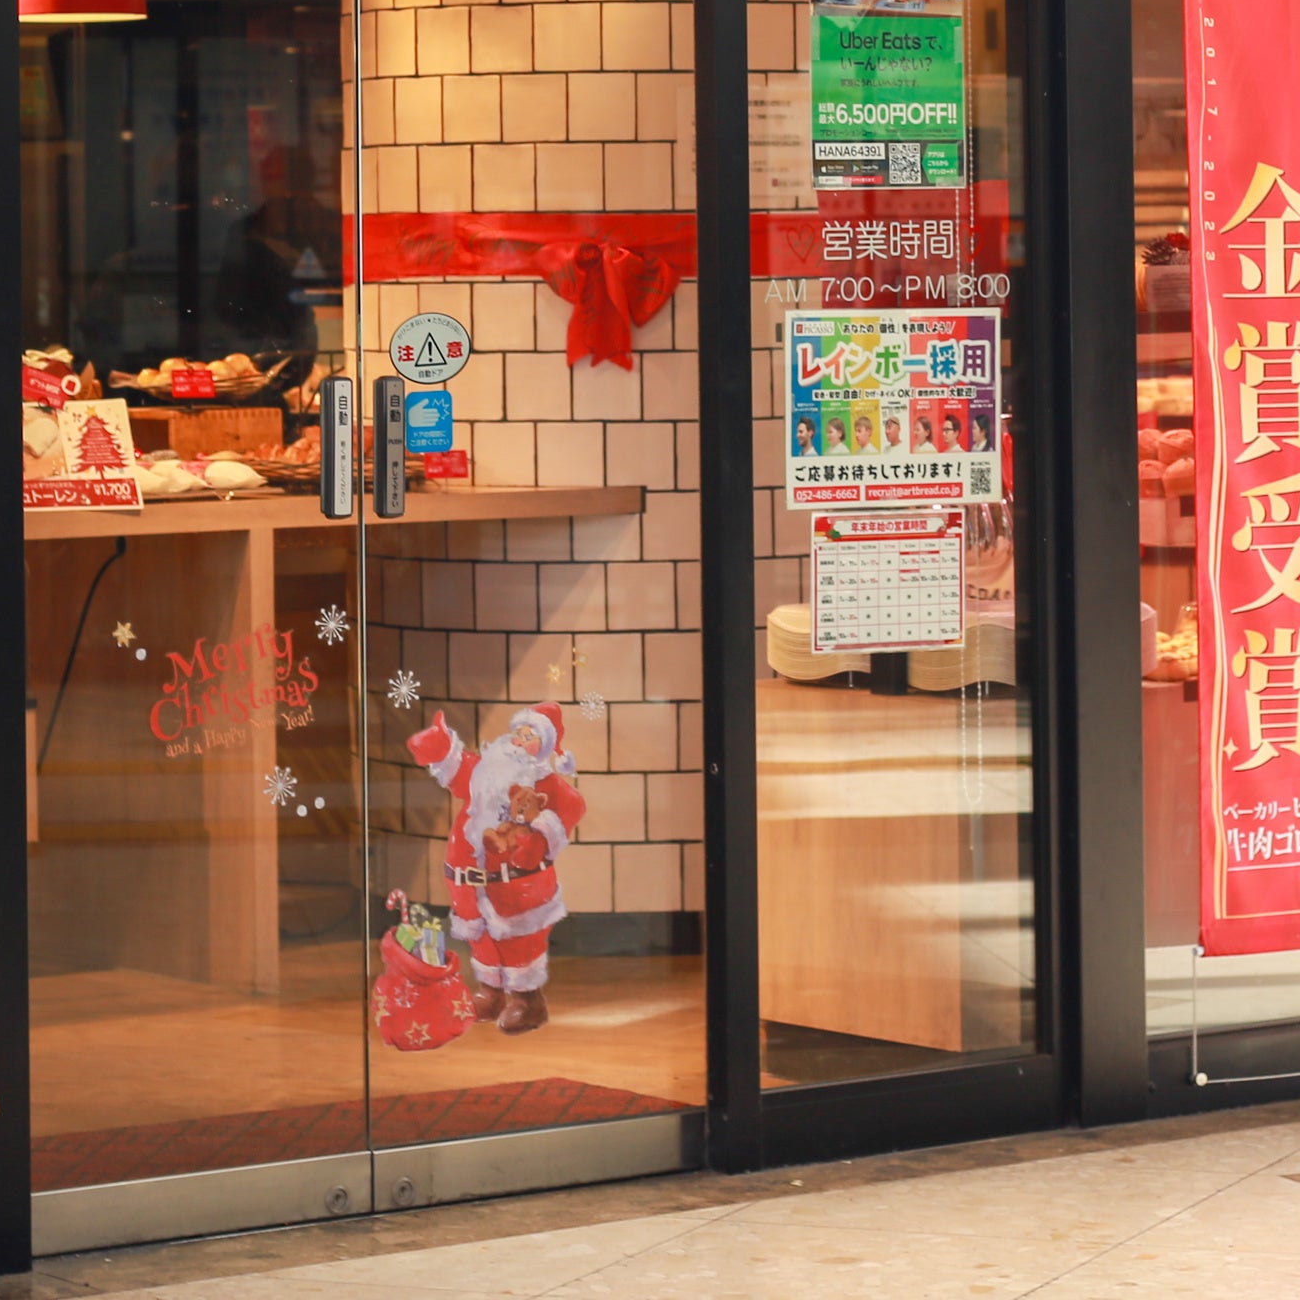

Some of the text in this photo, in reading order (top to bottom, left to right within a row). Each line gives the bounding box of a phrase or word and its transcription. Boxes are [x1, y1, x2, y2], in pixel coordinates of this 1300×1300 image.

[839, 30, 944, 51] Uber Eats で、
[840, 56, 933, 72] いーんじゃない？
[835, 102, 958, 126] 6,500円OFF!!
[1203, 16, 1219, 261] 2017-2023
[818, 145, 882, 157] HANA64391
[822, 219, 954, 261] 営業時間
[764, 278, 808, 303] AM
[956, 274, 1011, 300] 8:00
[397, 341, 463, 362] 注 意
[800, 342, 990, 382] レインボー採用
[418, 368, 444, 379] 自動ドア
[389, 394, 401, 422] 自動
[794, 461, 963, 483] ご応募お待ちしております！
[795, 484, 961, 501] 052-486-6662 recruit@artbread.co.jp
[851, 519, 928, 533] 年末年始の営業時間
[162, 622, 295, 695] Merry
[149, 656, 320, 741] Christmas
[165, 736, 190, 758] and
[204, 726, 247, 750] Happy
[280, 703, 317, 732] Year!
